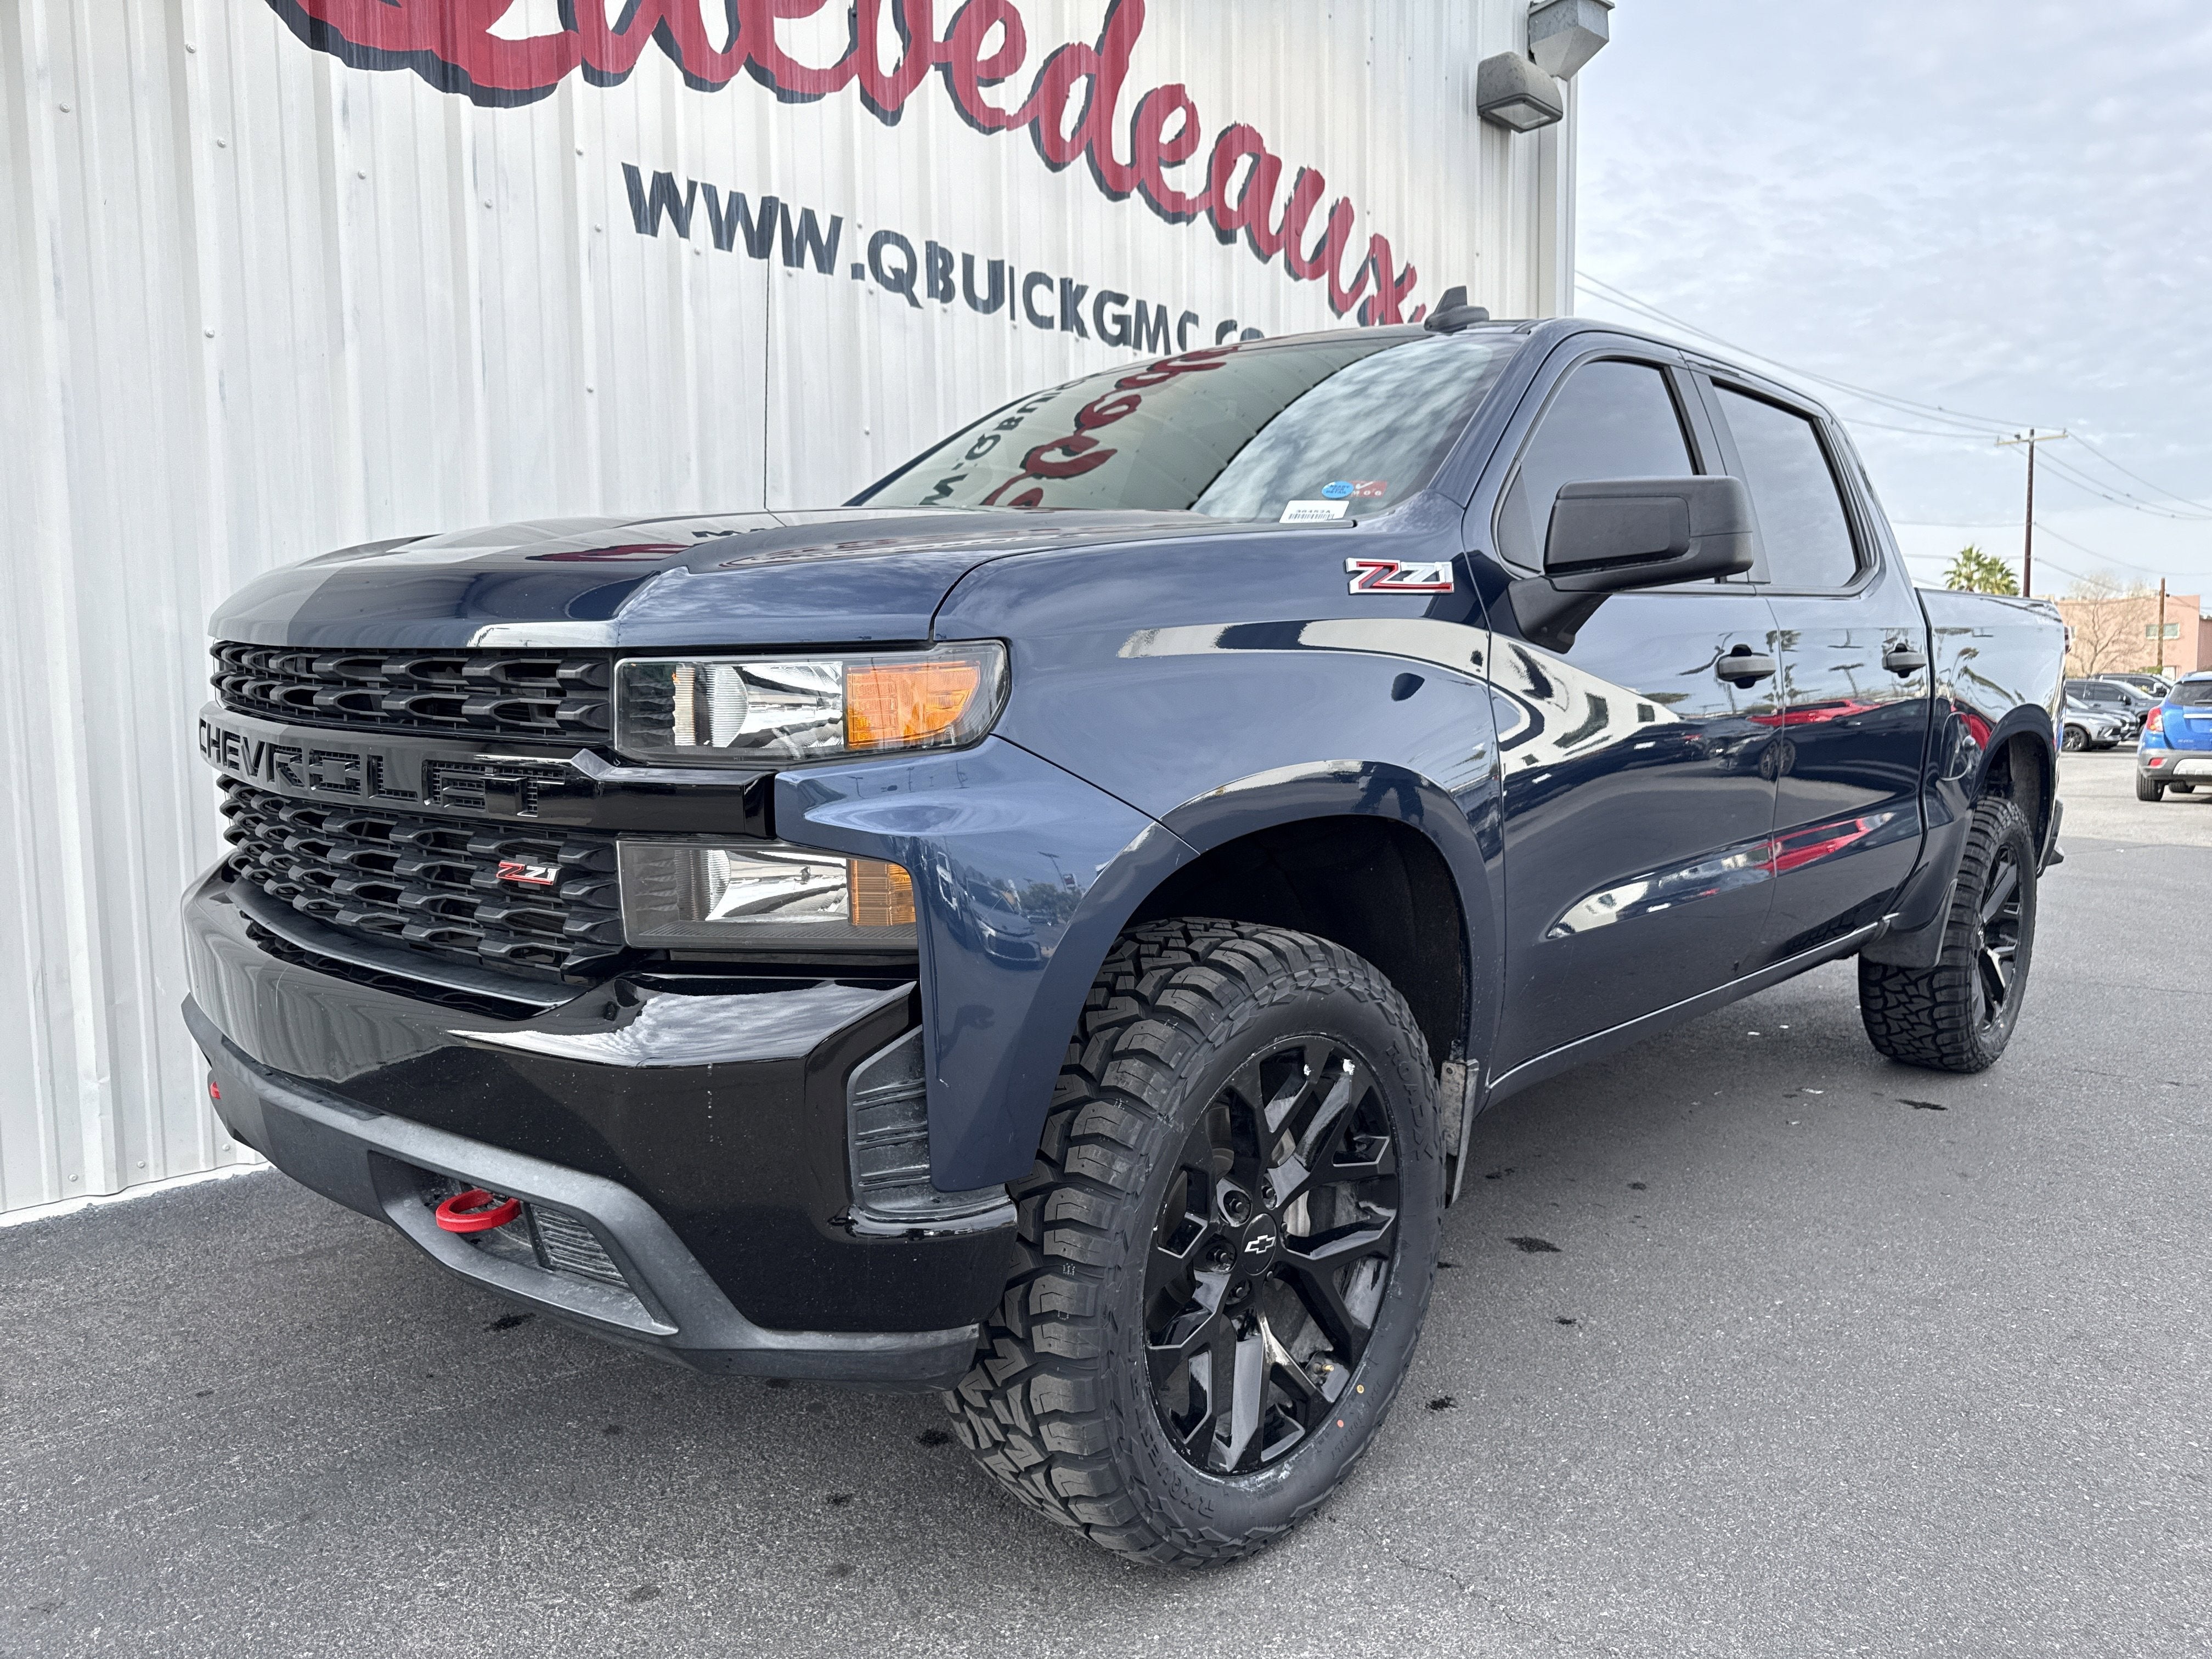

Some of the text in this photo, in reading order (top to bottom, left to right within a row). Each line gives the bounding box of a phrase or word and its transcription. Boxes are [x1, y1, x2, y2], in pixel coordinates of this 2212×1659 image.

[1344, 557, 1455, 595] Z71
[199, 717, 566, 817] CHEVROLET
[496, 861, 558, 886] Z71
